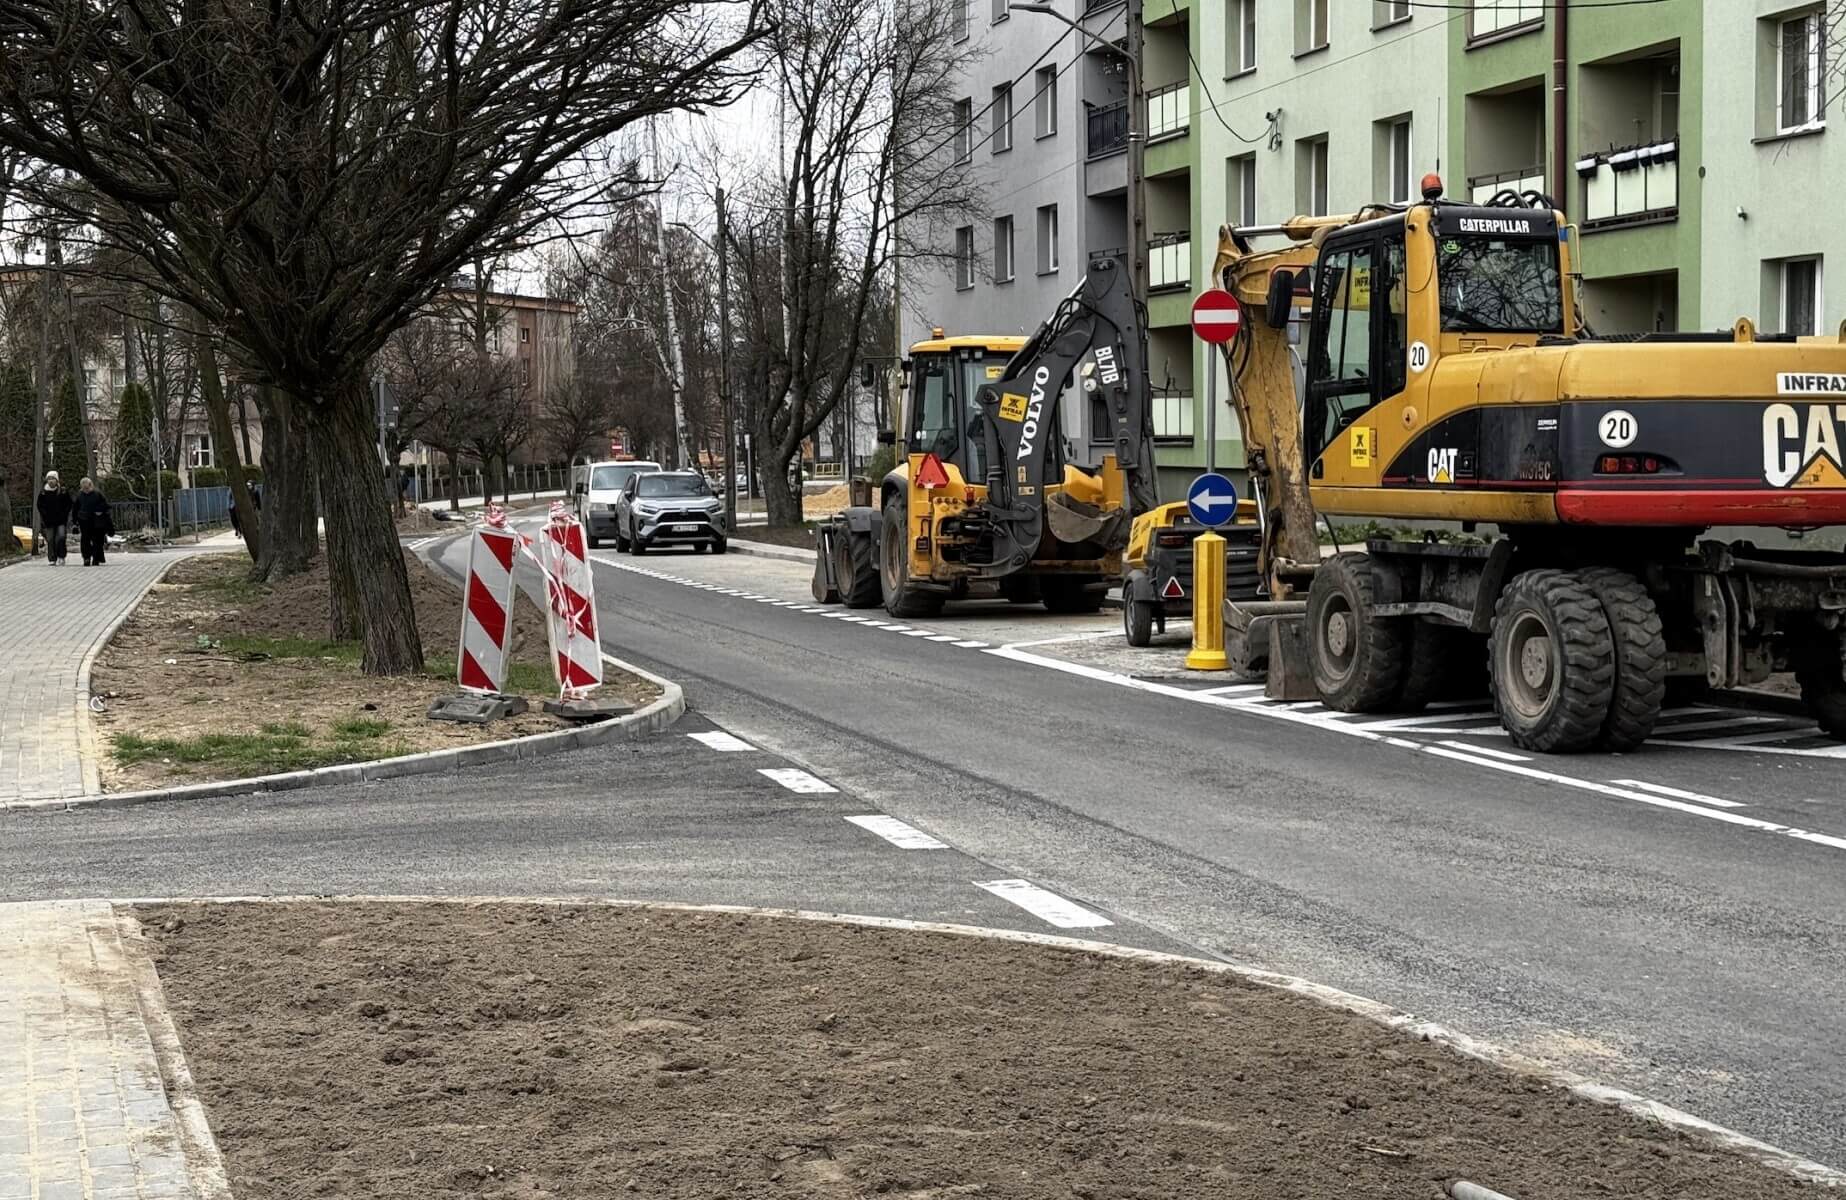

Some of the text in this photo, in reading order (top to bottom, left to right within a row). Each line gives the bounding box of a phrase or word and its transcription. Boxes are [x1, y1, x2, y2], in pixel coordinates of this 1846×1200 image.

[1460, 218, 1530, 233] CATERPILLAR
[1095, 346, 1119, 384] BL71B
[1412, 346, 1425, 366] 20
[1017, 366, 1049, 460] VOLVO
[1606, 417, 1630, 440] 20
[1427, 447, 1458, 483] CAT
